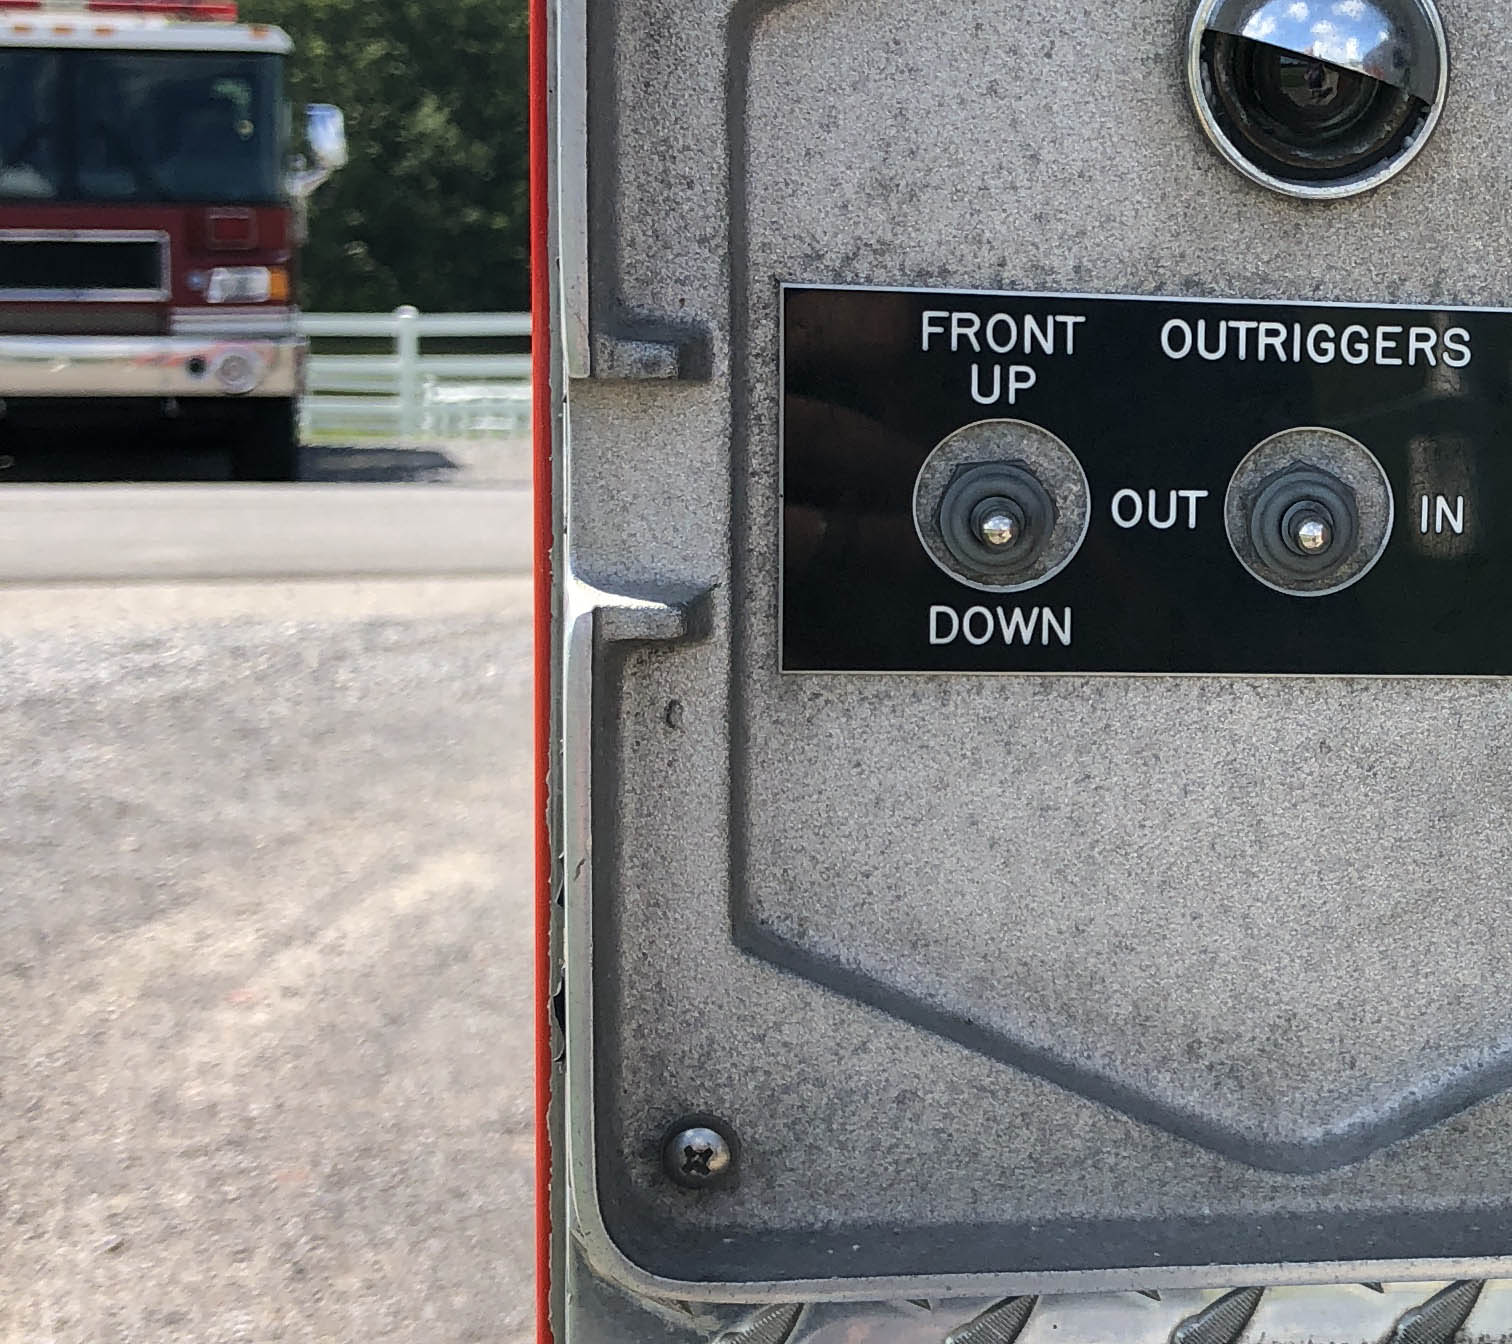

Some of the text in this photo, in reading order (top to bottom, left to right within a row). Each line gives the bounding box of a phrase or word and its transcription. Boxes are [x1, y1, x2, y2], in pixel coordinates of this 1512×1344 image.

[922, 310, 1086, 355] FRONT
[1161, 318, 1471, 367] OUTRIGGERS
[971, 363, 1036, 405] UP
[1111, 488, 1209, 529] OUT
[1421, 494, 1464, 534] IN
[929, 605, 1071, 646] DOWN
